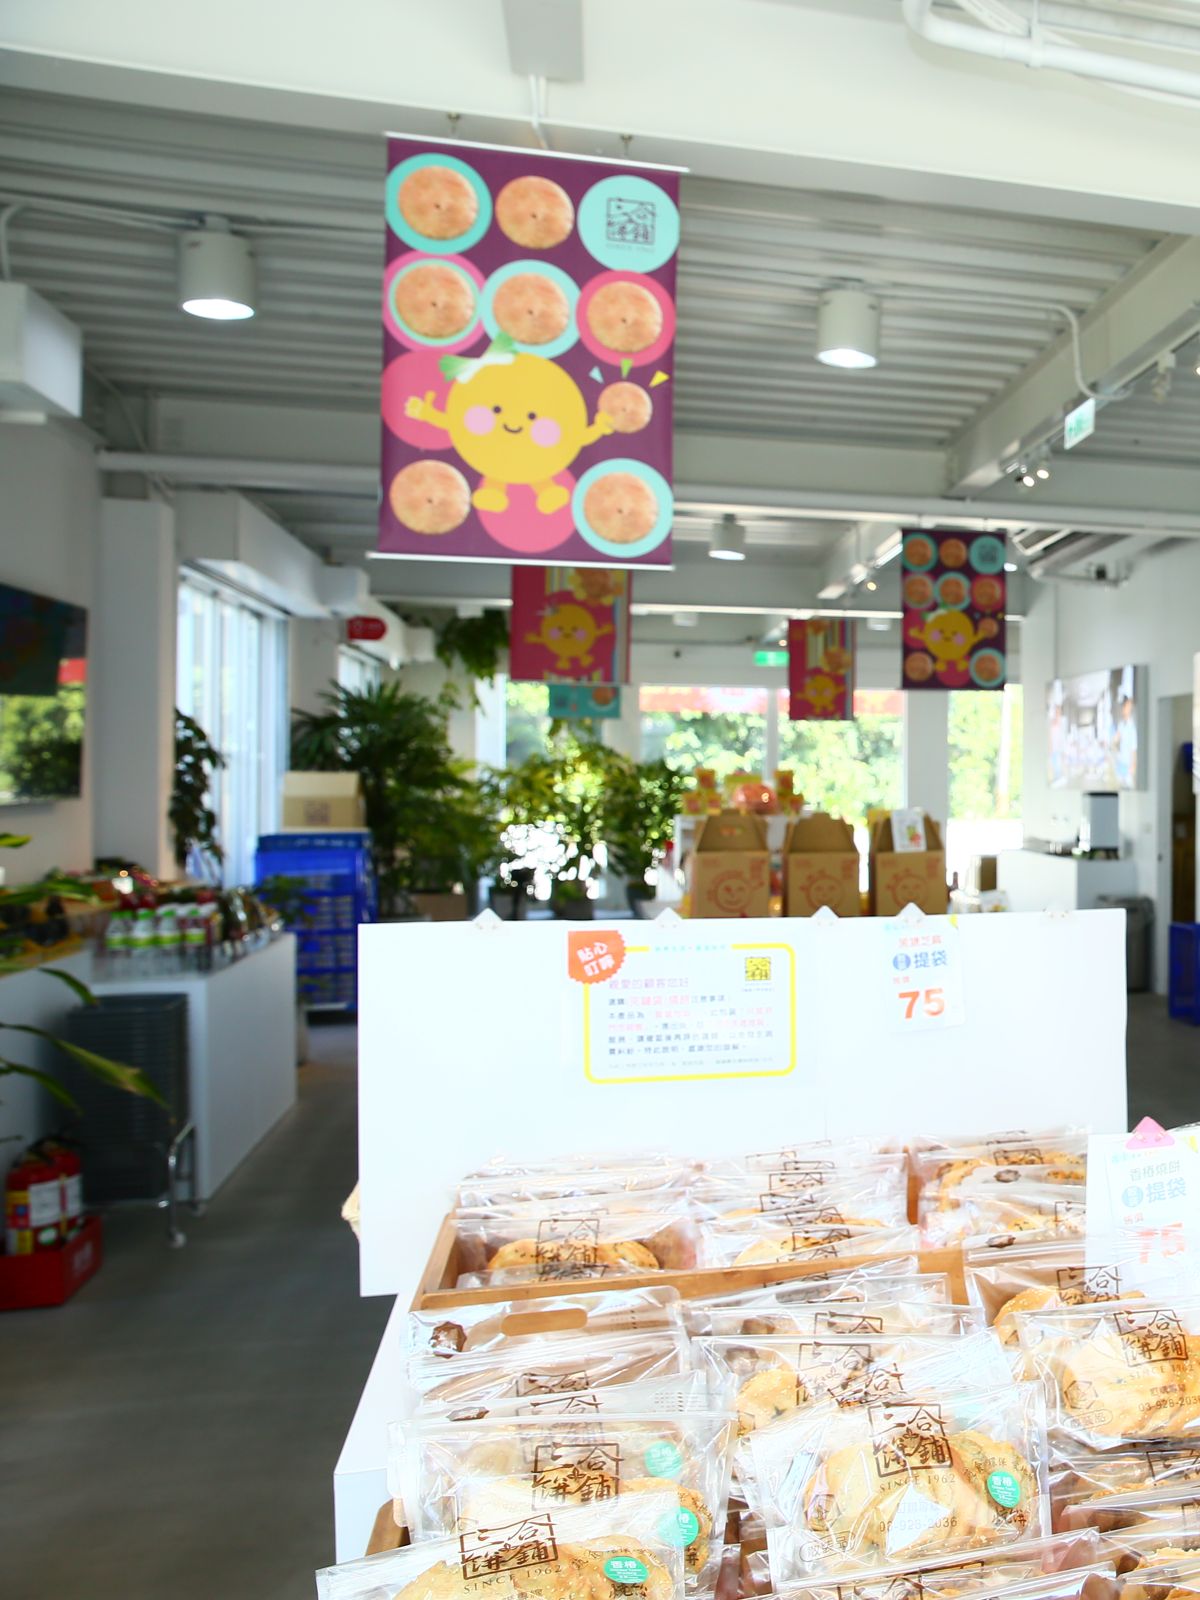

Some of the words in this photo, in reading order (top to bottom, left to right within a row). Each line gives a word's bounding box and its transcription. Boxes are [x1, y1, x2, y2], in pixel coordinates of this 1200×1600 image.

[577, 942, 608, 963] 貼心
[914, 950, 947, 969] 提袋
[899, 988, 945, 1020] 75
[1147, 1177, 1187, 1203] 提袋
[880, 1475, 921, 1492] SINCE
[927, 1472, 956, 1484] 1962
[464, 1573, 516, 1594] SINCE
[526, 1564, 562, 1578] 1962
